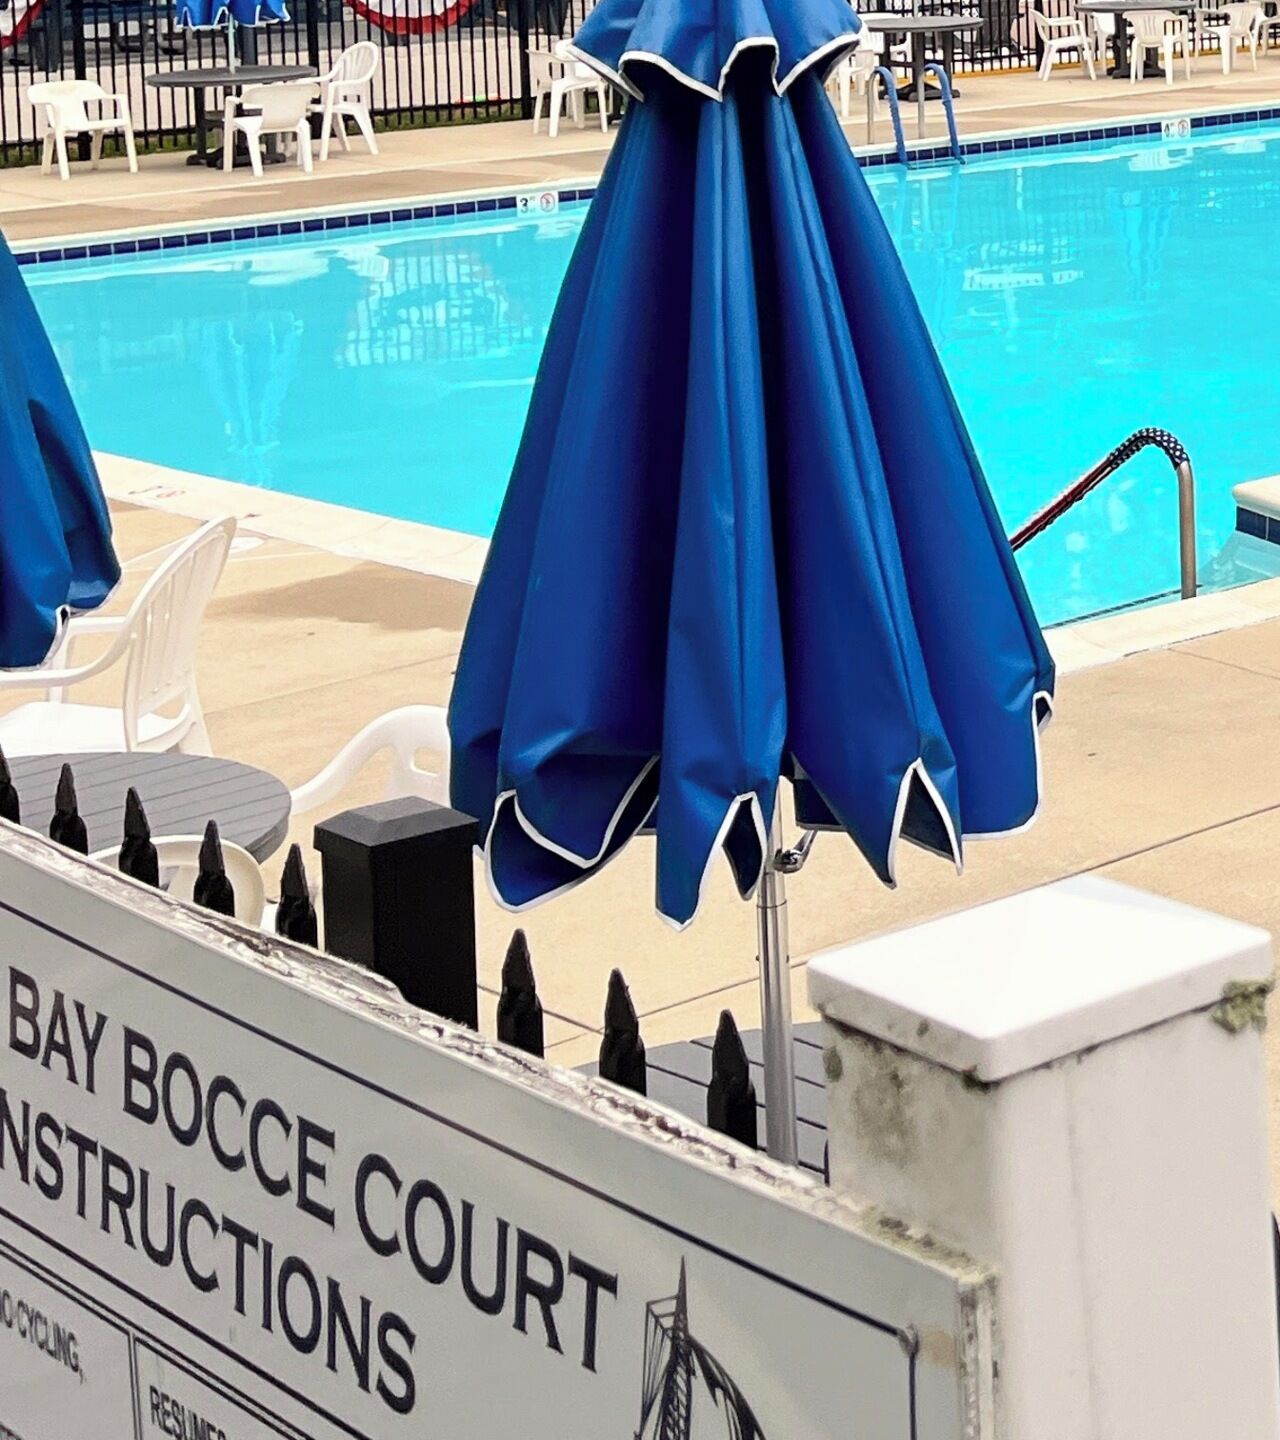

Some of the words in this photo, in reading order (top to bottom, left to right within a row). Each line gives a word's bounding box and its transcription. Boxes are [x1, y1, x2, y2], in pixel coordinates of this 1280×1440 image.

[9, 966, 108, 1094] BAY
[123, 1025, 337, 1233] BOCCE
[354, 1152, 619, 1374] COURT
[0, 1286, 13, 1329] O
